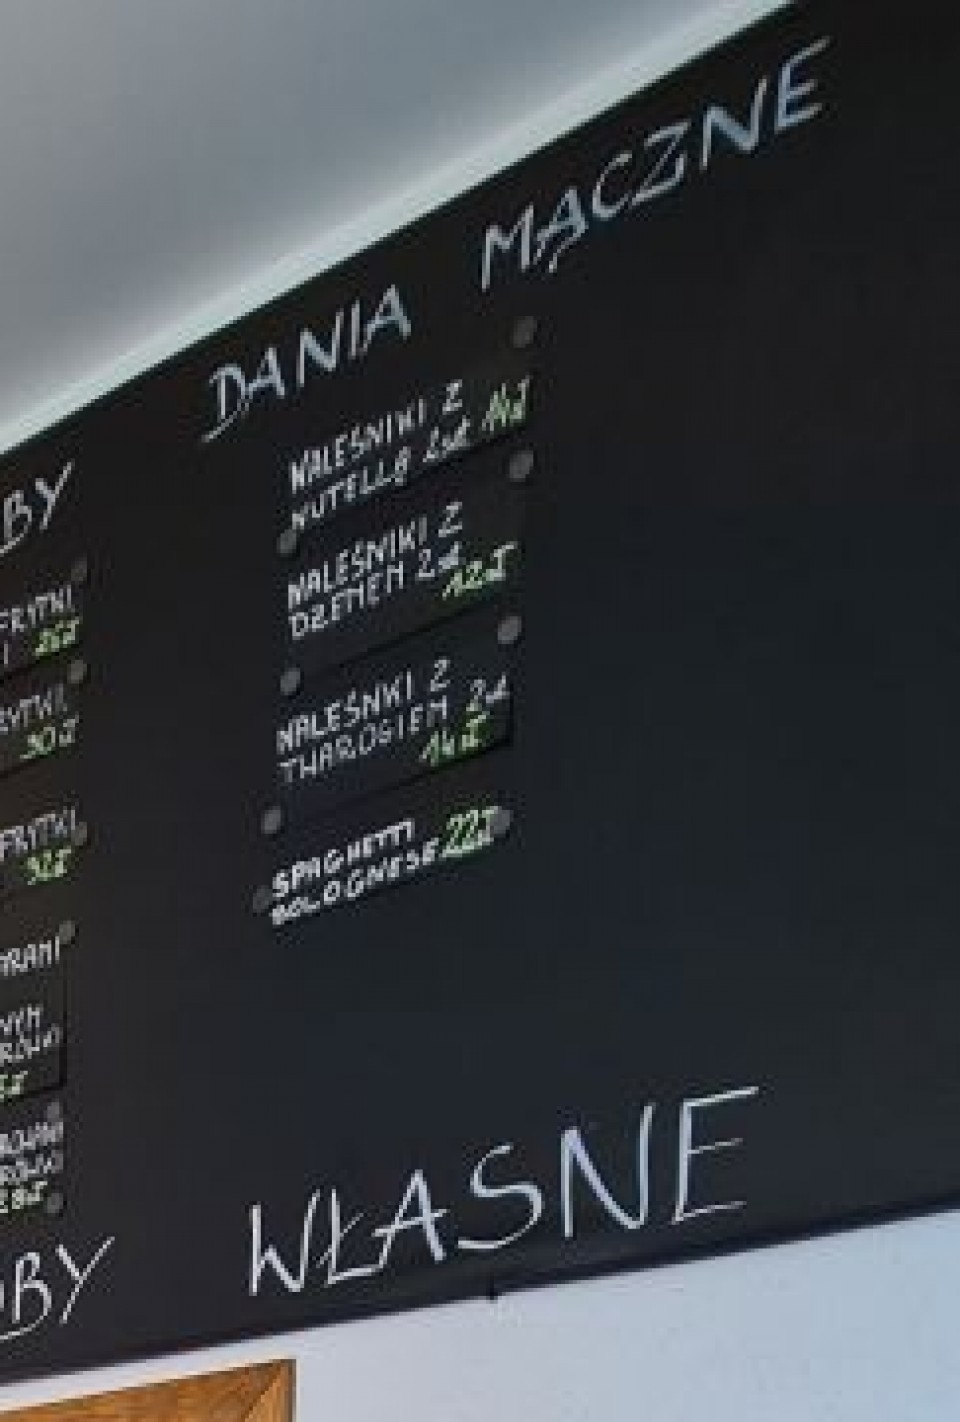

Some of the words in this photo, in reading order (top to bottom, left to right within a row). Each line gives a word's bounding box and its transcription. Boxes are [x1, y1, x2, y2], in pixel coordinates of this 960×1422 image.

[202, 284, 412, 442] DANIA
[480, 36, 830, 291] MĄCZNE
[290, 397, 426, 495] NALEŚNIKI
[441, 379, 464, 415] Z
[288, 516, 428, 610] NALEŚNIKI
[437, 501, 464, 538] Z
[272, 818, 415, 900] SPAGHETTI
[248, 1086, 759, 1297] WŁASNE
